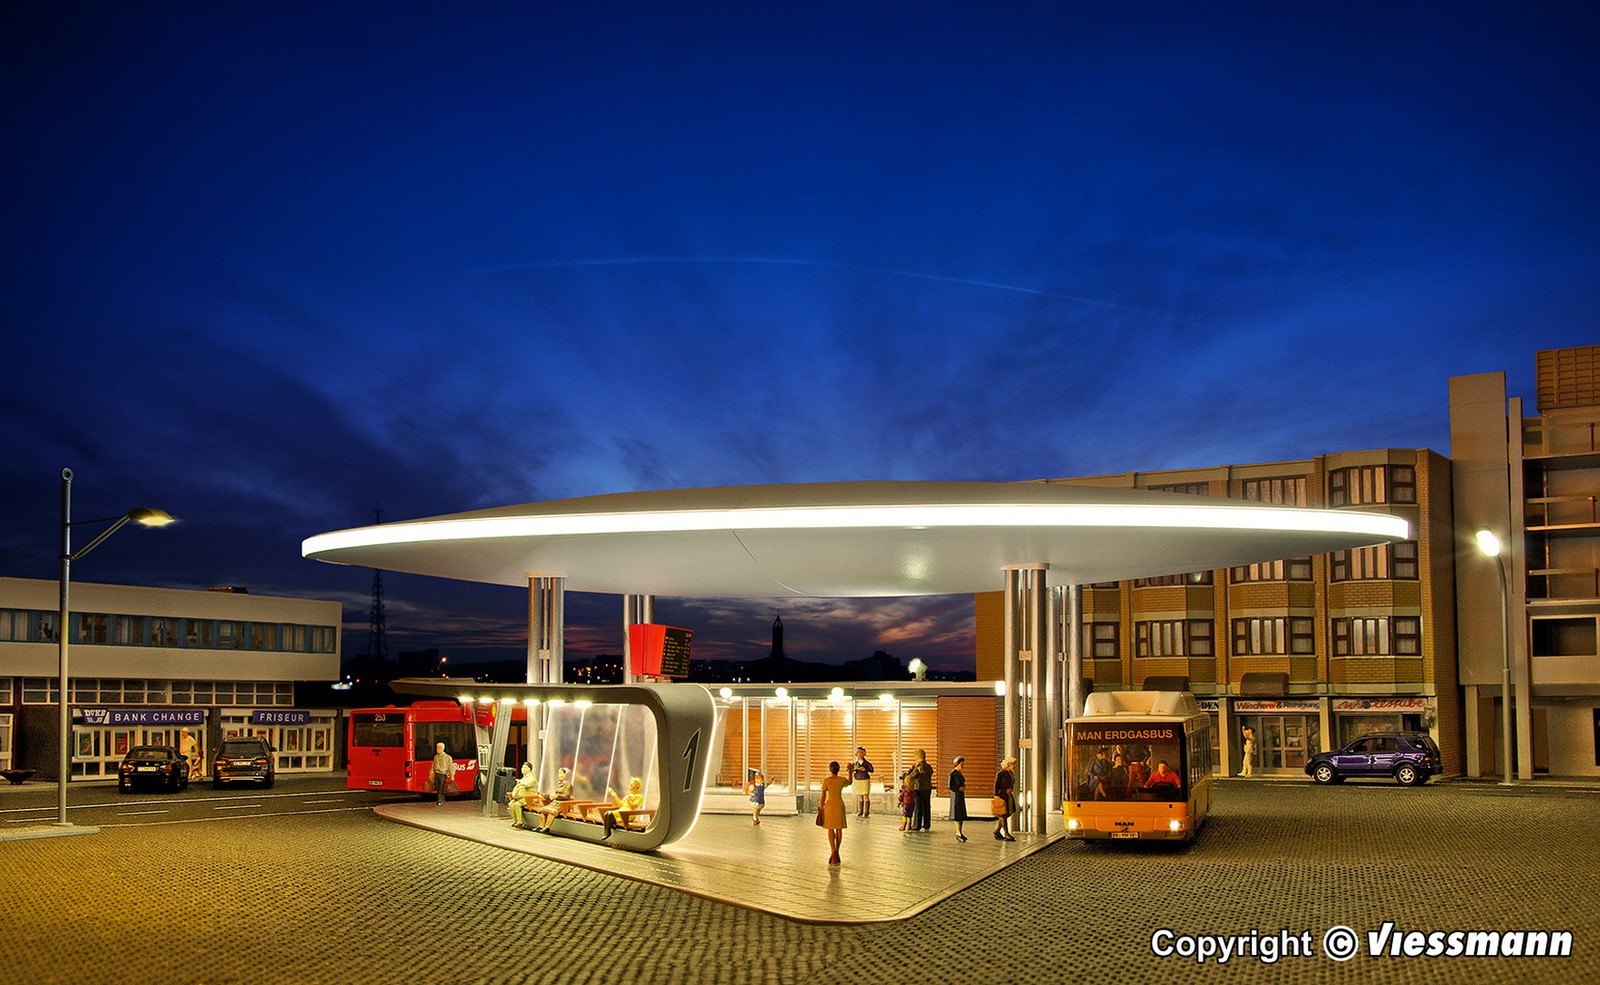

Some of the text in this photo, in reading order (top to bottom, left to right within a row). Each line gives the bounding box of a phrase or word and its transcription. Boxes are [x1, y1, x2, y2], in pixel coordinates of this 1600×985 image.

[114, 713, 147, 722] BANK
[152, 712, 200, 722] CHANGE
[260, 713, 304, 722] FRISEUR
[1077, 729, 1173, 740] MAN ERDGASBUS
[682, 727, 701, 793] 1
